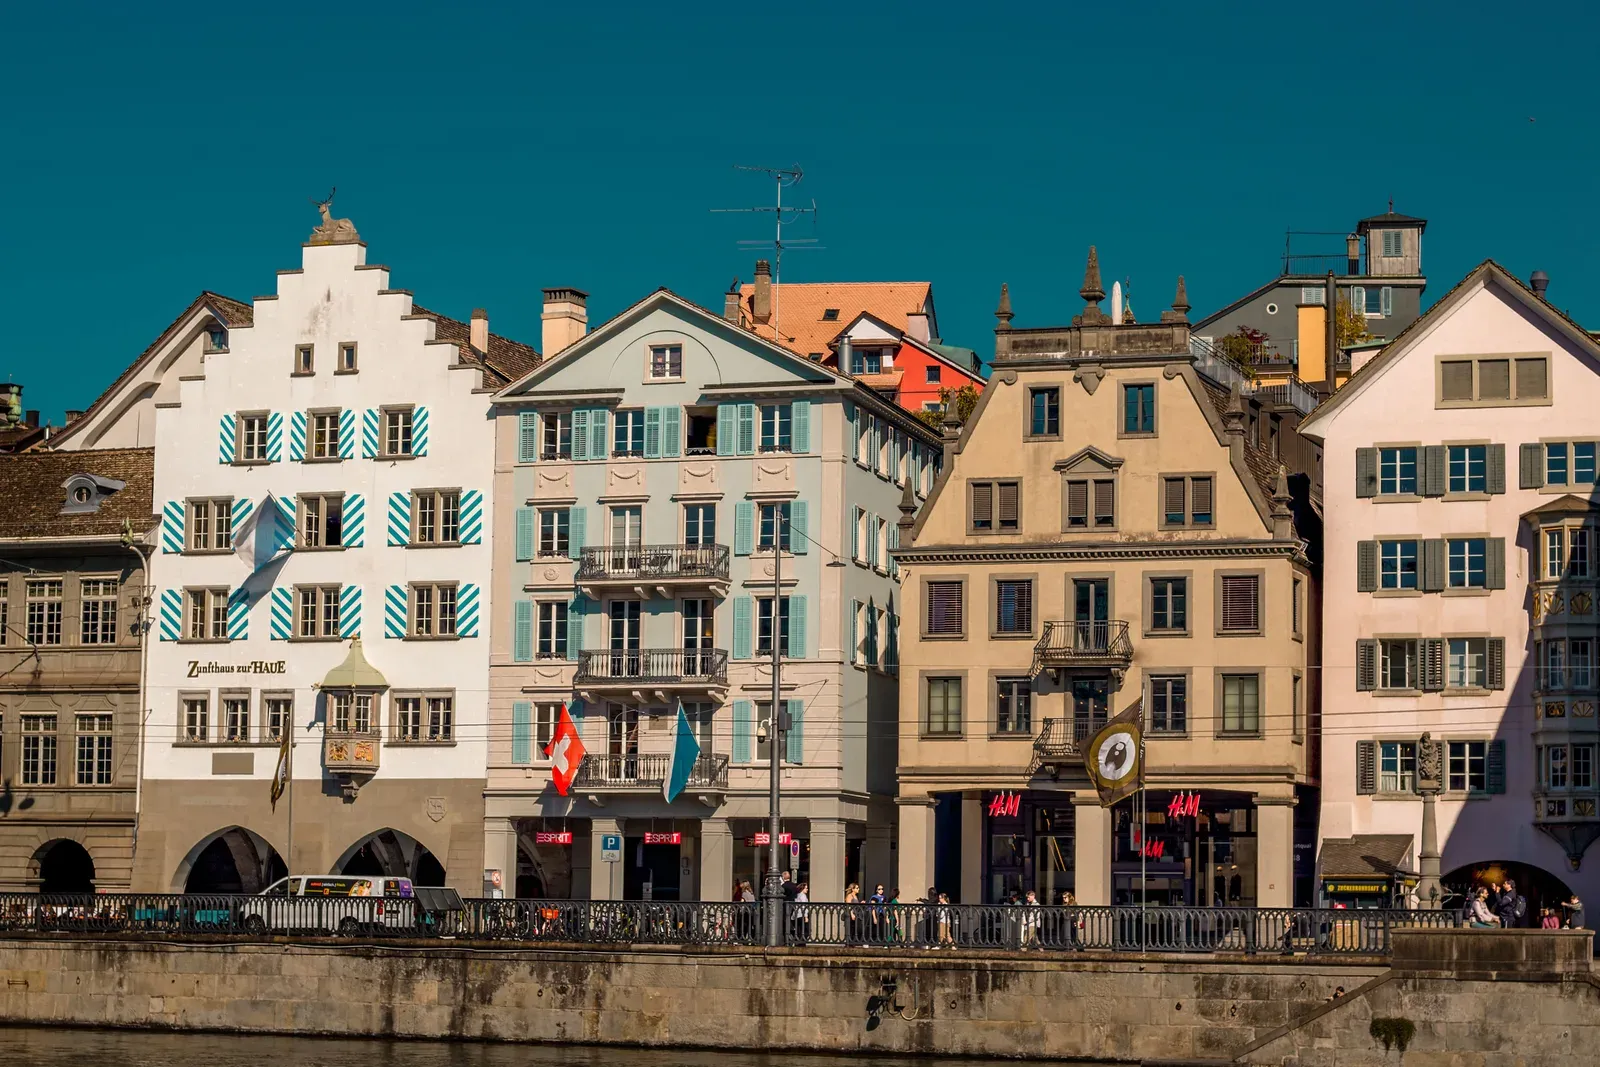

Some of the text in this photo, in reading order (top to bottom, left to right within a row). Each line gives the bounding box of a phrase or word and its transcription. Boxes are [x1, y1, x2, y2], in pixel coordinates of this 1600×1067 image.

[187, 661, 286, 678] Zunfthaus zur HAUE
[988, 795, 1021, 817] H&M
[1167, 795, 1201, 817] H&M
[536, 832, 570, 844] ESPRIT
[607, 837, 615, 849] P
[645, 832, 678, 844] ESPRIT
[755, 833, 789, 845] ESIT
